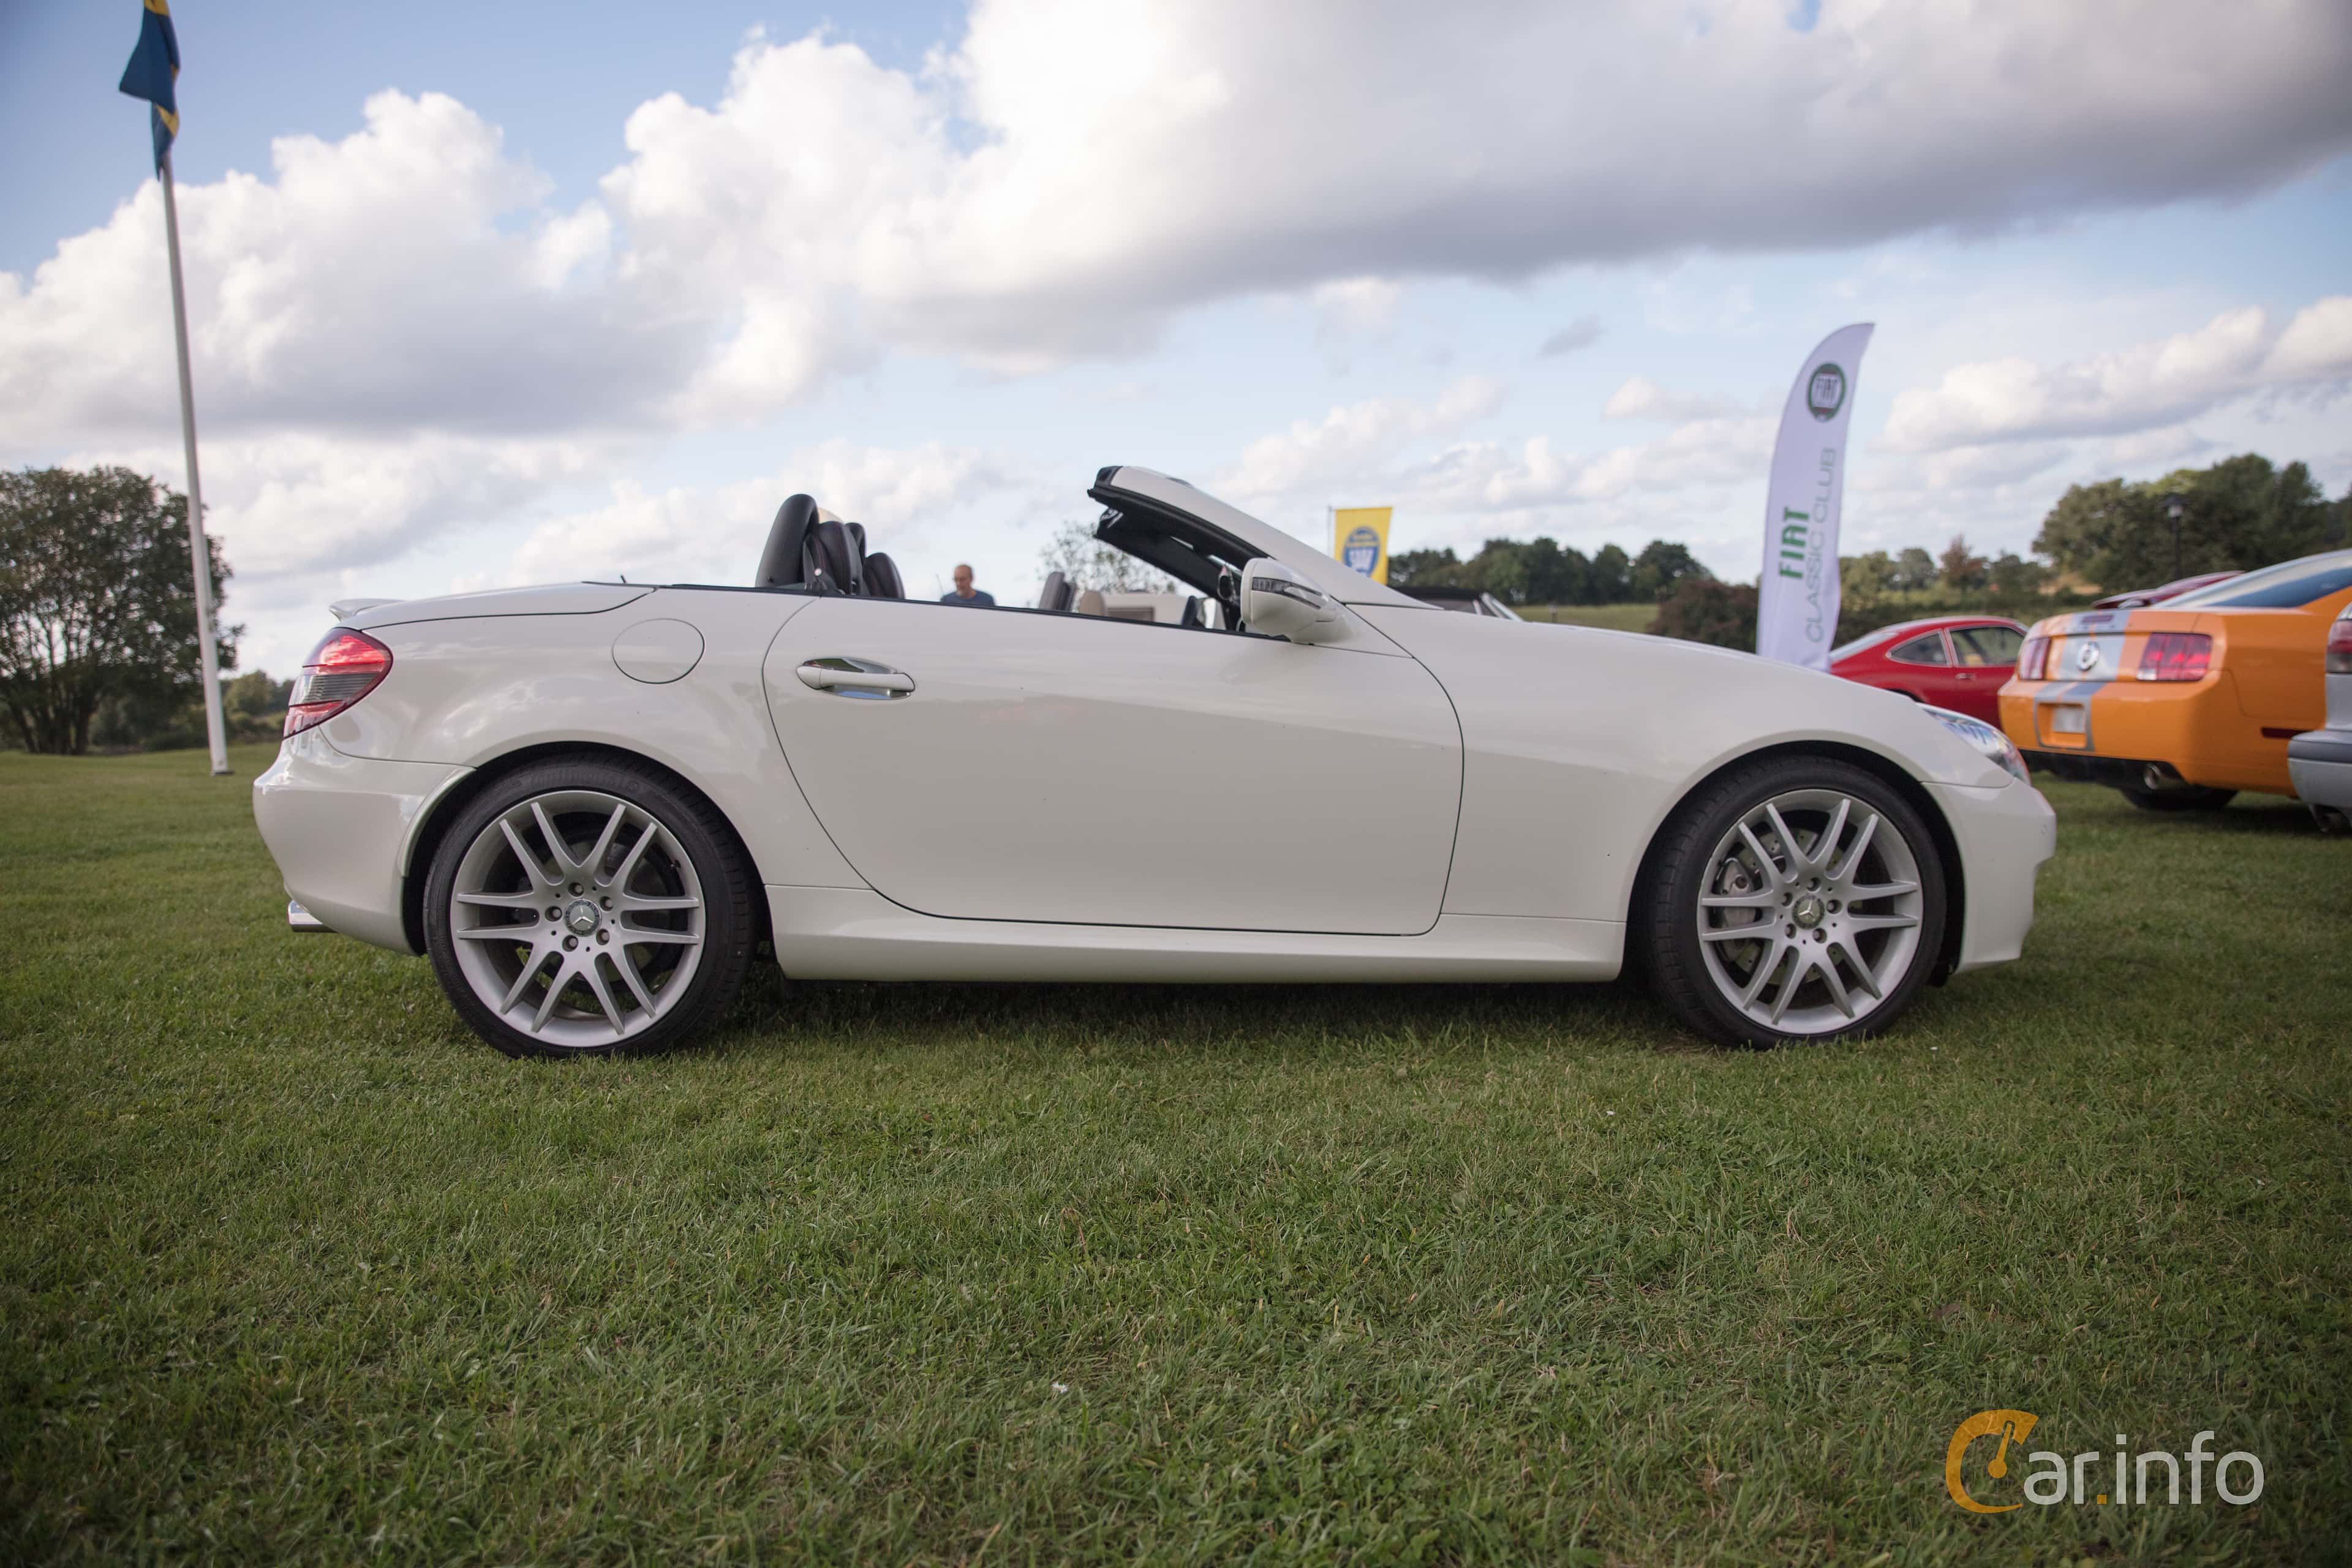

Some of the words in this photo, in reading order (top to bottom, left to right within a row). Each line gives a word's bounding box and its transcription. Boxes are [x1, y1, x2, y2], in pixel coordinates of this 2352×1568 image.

[1812, 447, 1837, 524] CLUB
[1778, 505, 1811, 579] FIAT
[1805, 530, 1825, 643] CLASSIC
